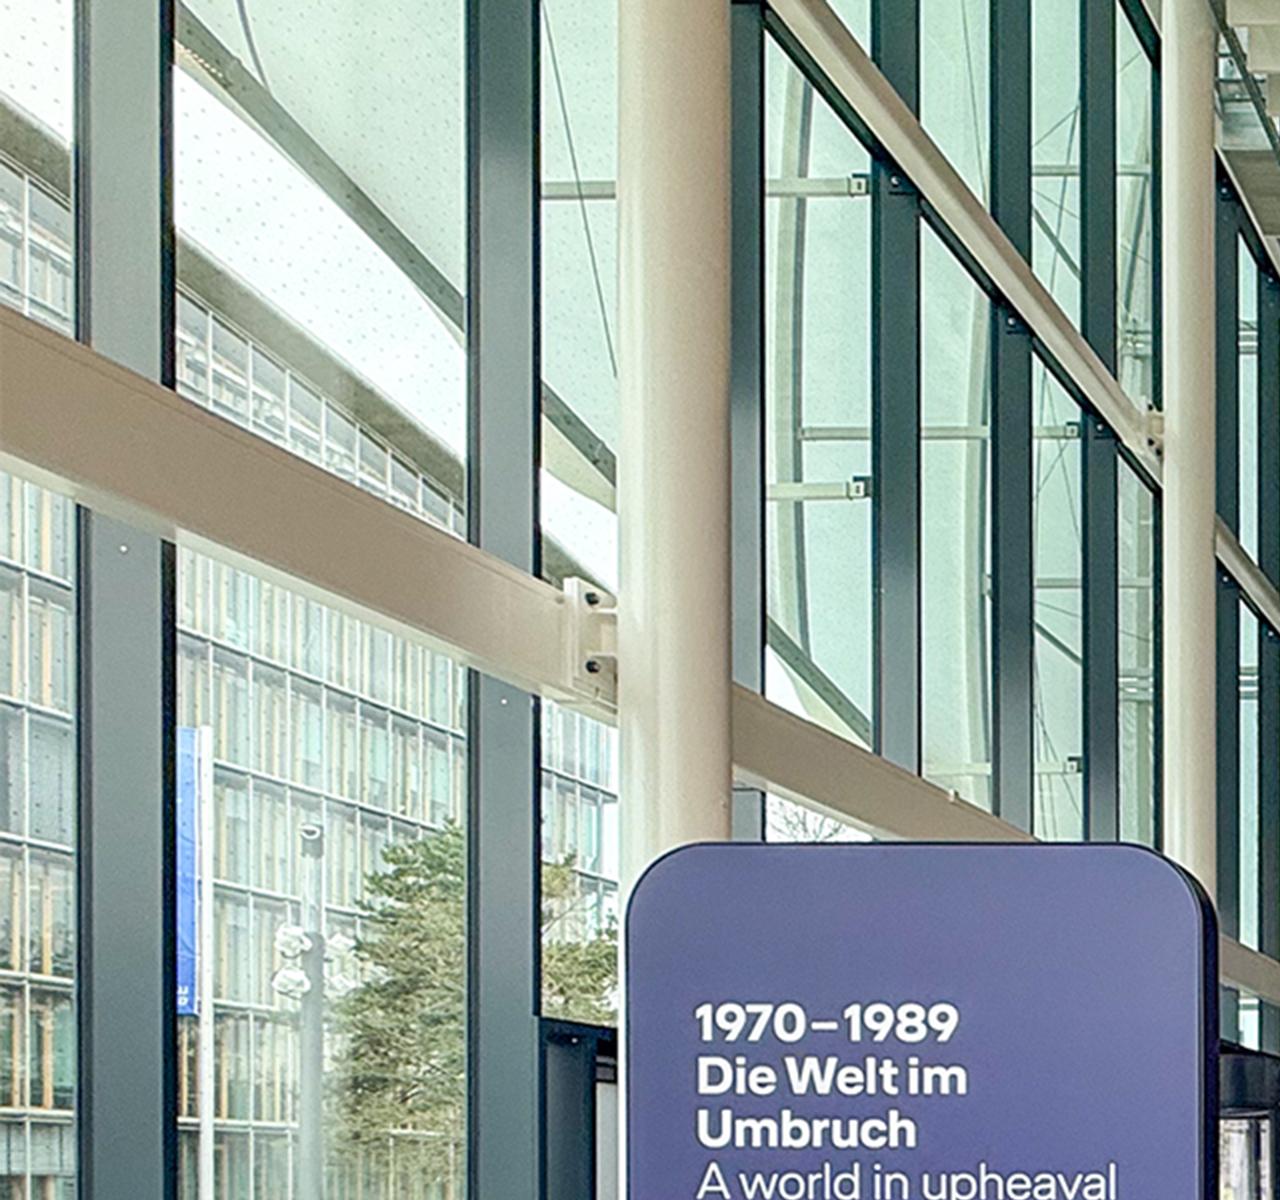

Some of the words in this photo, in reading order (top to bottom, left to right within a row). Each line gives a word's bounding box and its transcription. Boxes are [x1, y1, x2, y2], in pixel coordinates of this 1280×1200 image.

[695, 1003, 959, 1043] 1970–1989
[698, 1056, 777, 1095] Die
[784, 1056, 899, 1095] Welt
[908, 1056, 967, 1095] im
[698, 1109, 916, 1148] Umbruch
[696, 1162, 731, 1200] A
[739, 1162, 860, 1200] world
[873, 1163, 909, 1200] in
